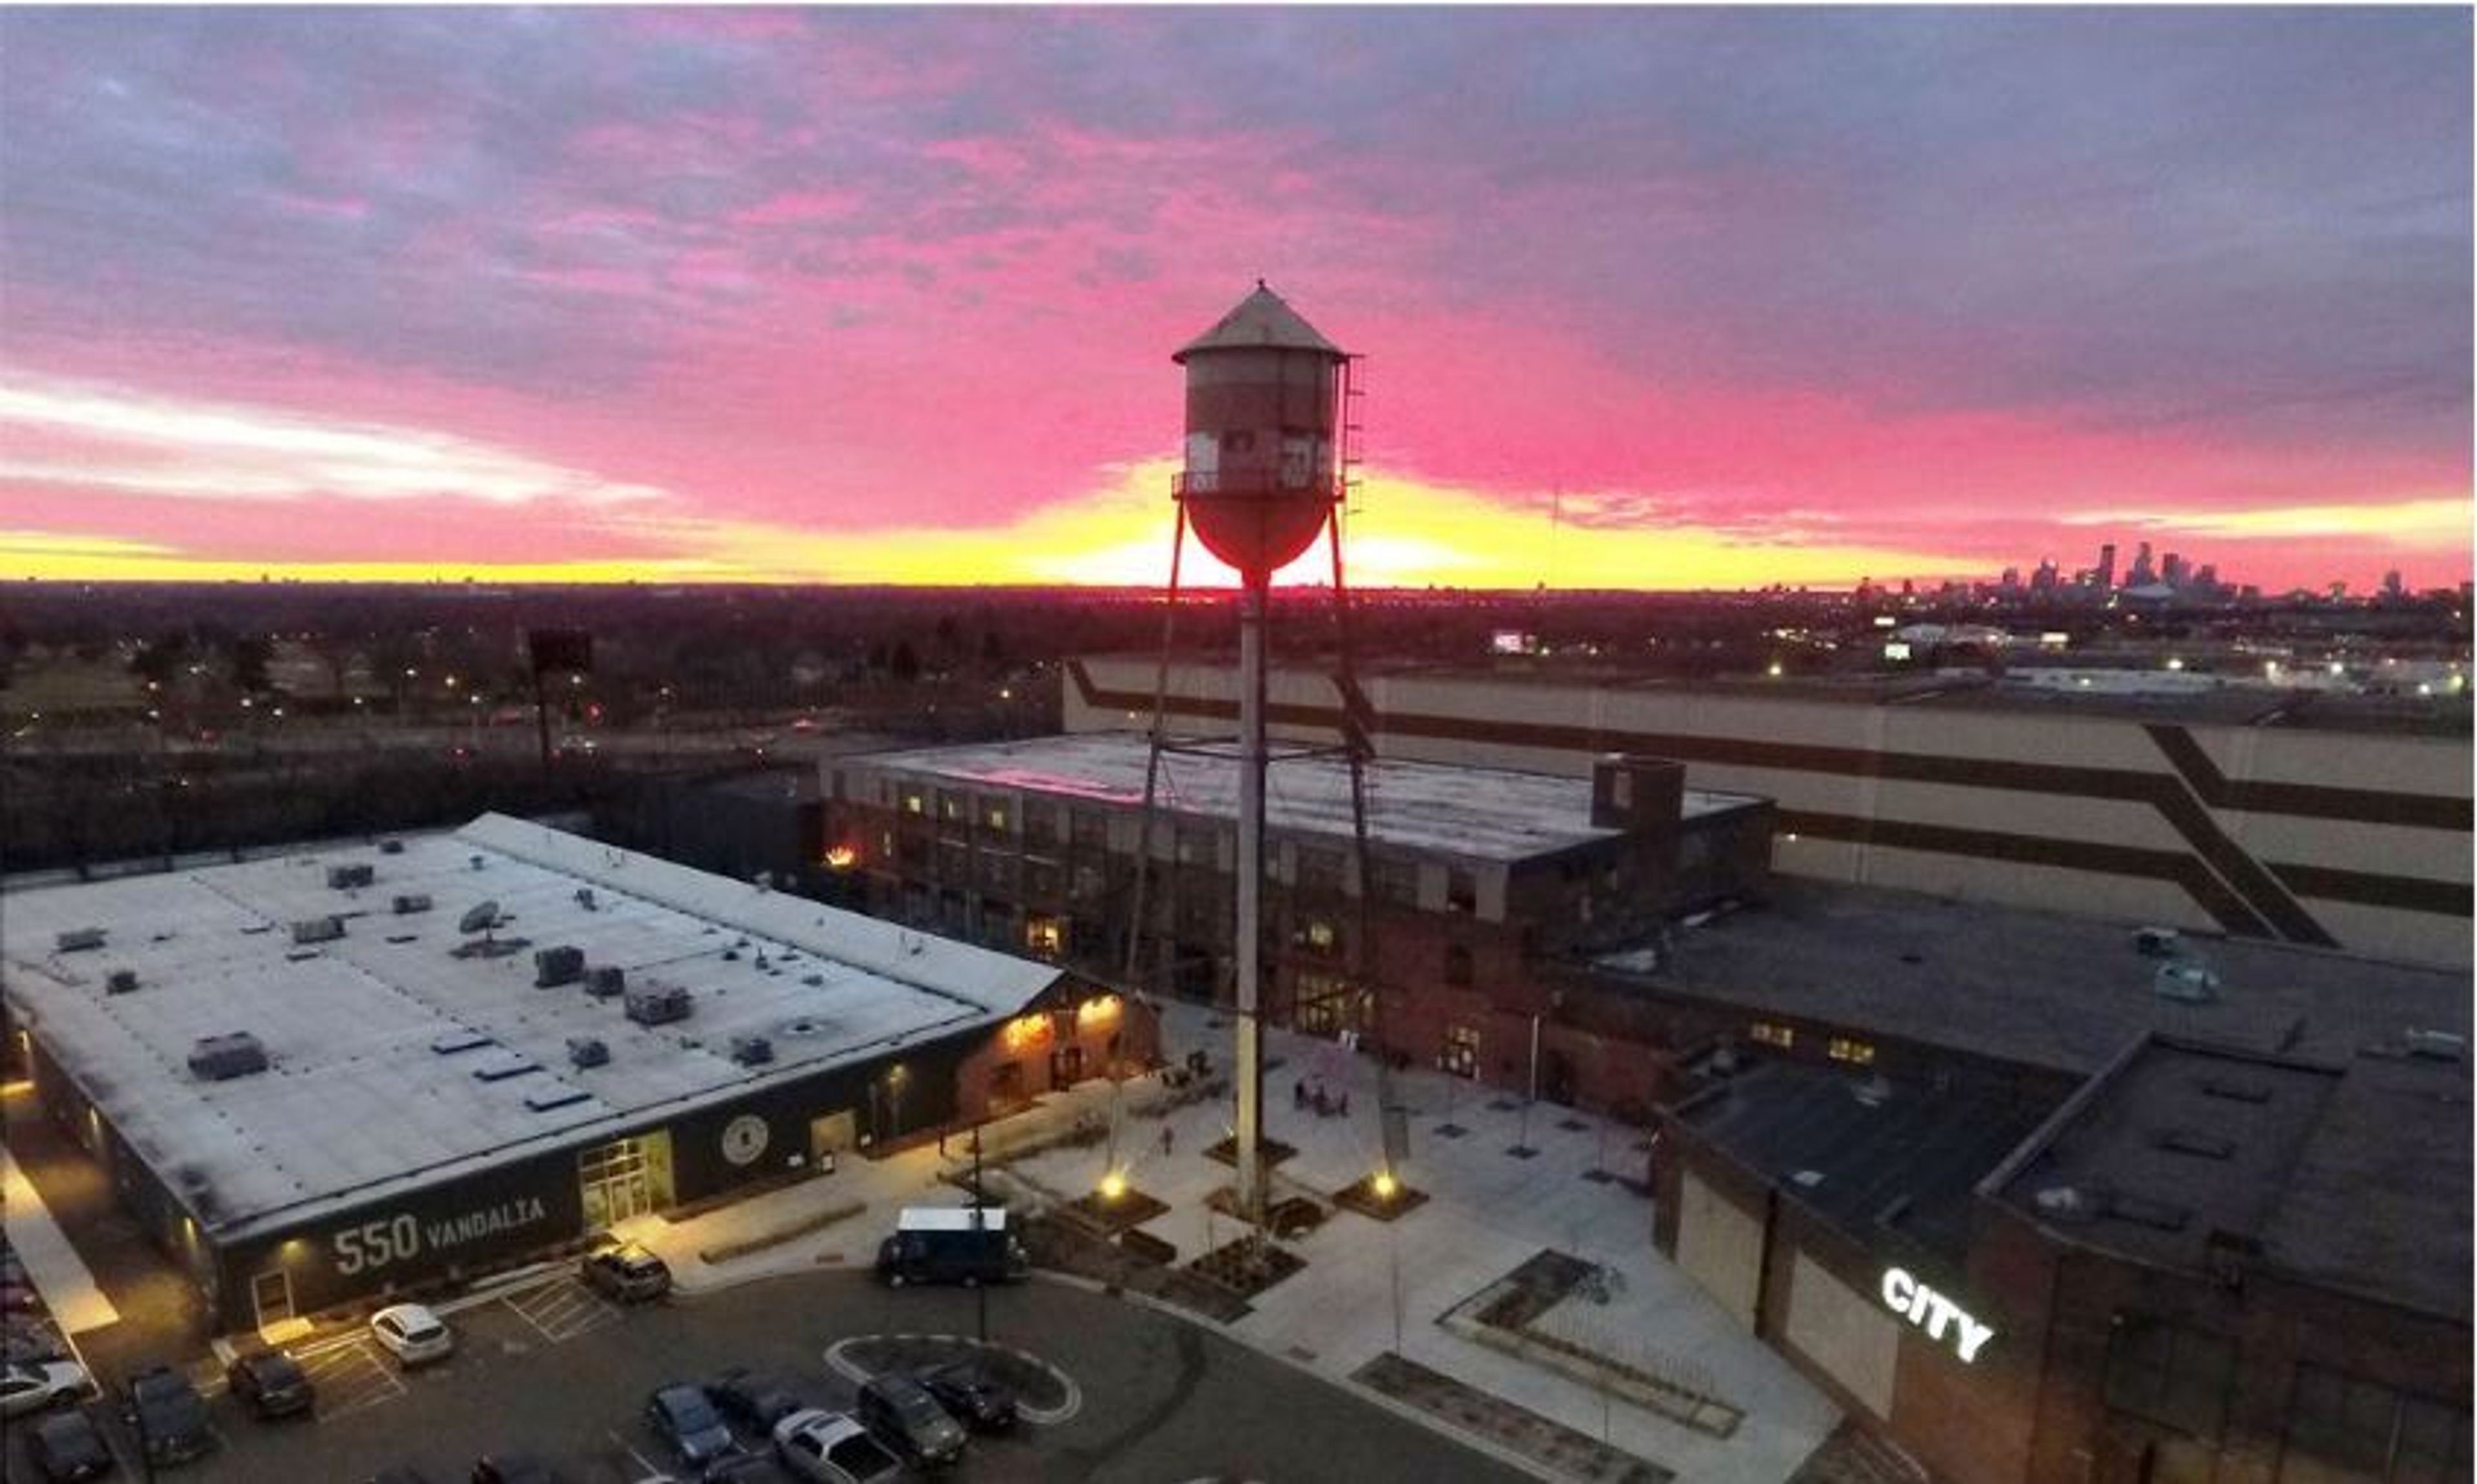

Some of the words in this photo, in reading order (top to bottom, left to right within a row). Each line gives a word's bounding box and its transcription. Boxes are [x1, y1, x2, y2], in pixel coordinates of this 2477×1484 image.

[335, 1214, 421, 1274] 550
[426, 1197, 545, 1249] VANDALIA
[1882, 1268, 1995, 1363] CITY
